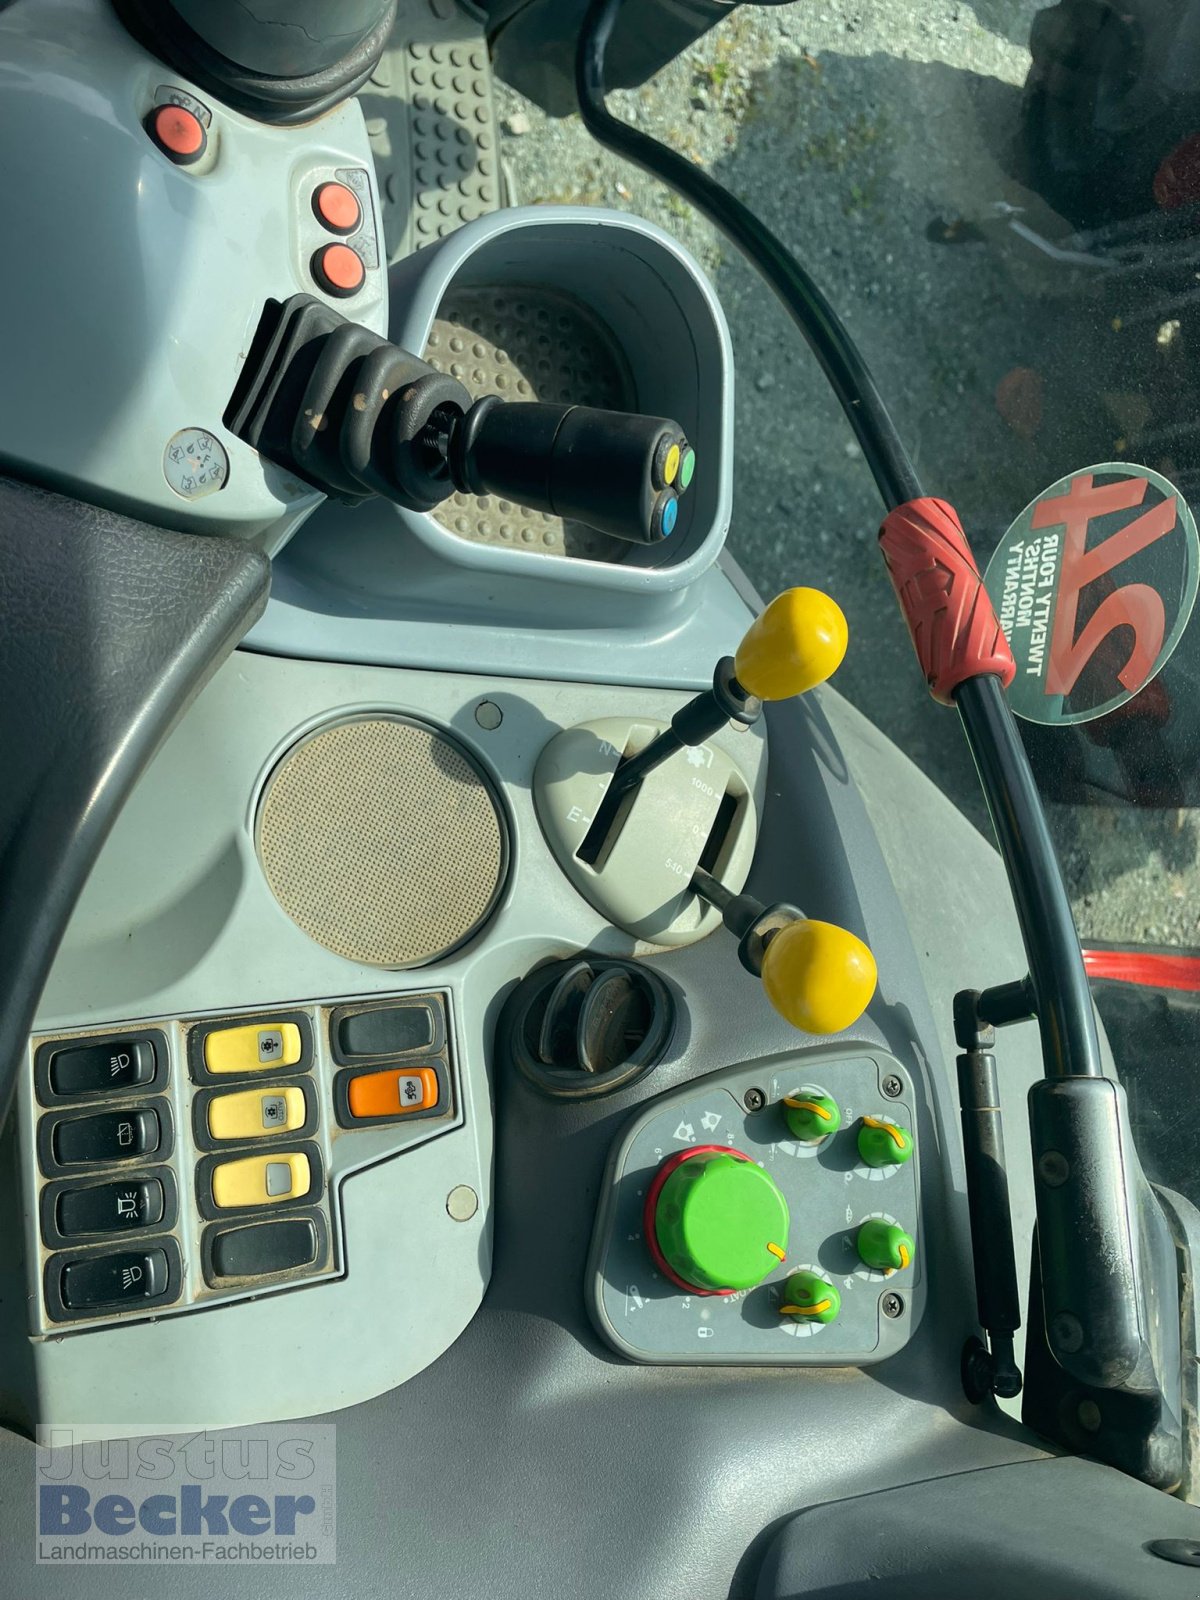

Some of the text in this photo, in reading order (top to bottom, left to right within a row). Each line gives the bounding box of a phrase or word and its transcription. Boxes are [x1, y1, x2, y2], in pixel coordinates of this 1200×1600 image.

[691, 777, 713, 797] 1000
[566, 806, 583, 823] E
[664, 858, 684, 874] 540
